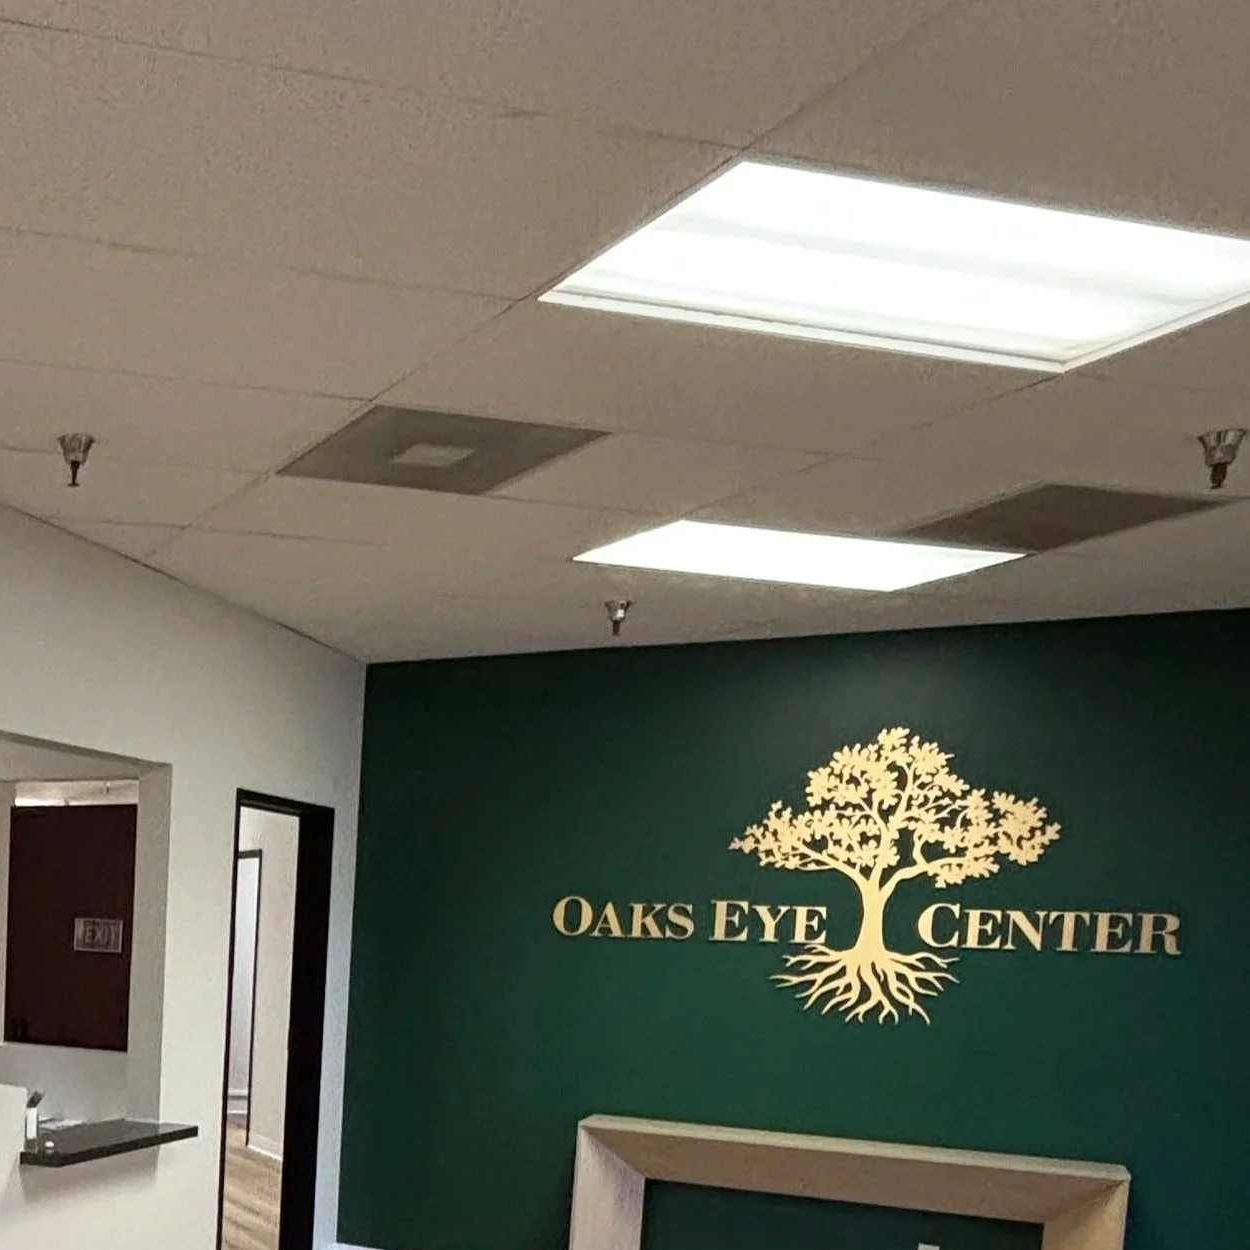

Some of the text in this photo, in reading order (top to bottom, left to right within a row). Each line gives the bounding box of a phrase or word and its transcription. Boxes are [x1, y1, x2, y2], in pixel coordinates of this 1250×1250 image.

[85, 926, 118, 944] EXIT
[552, 896, 1182, 955] OAKS EYE CENTER
